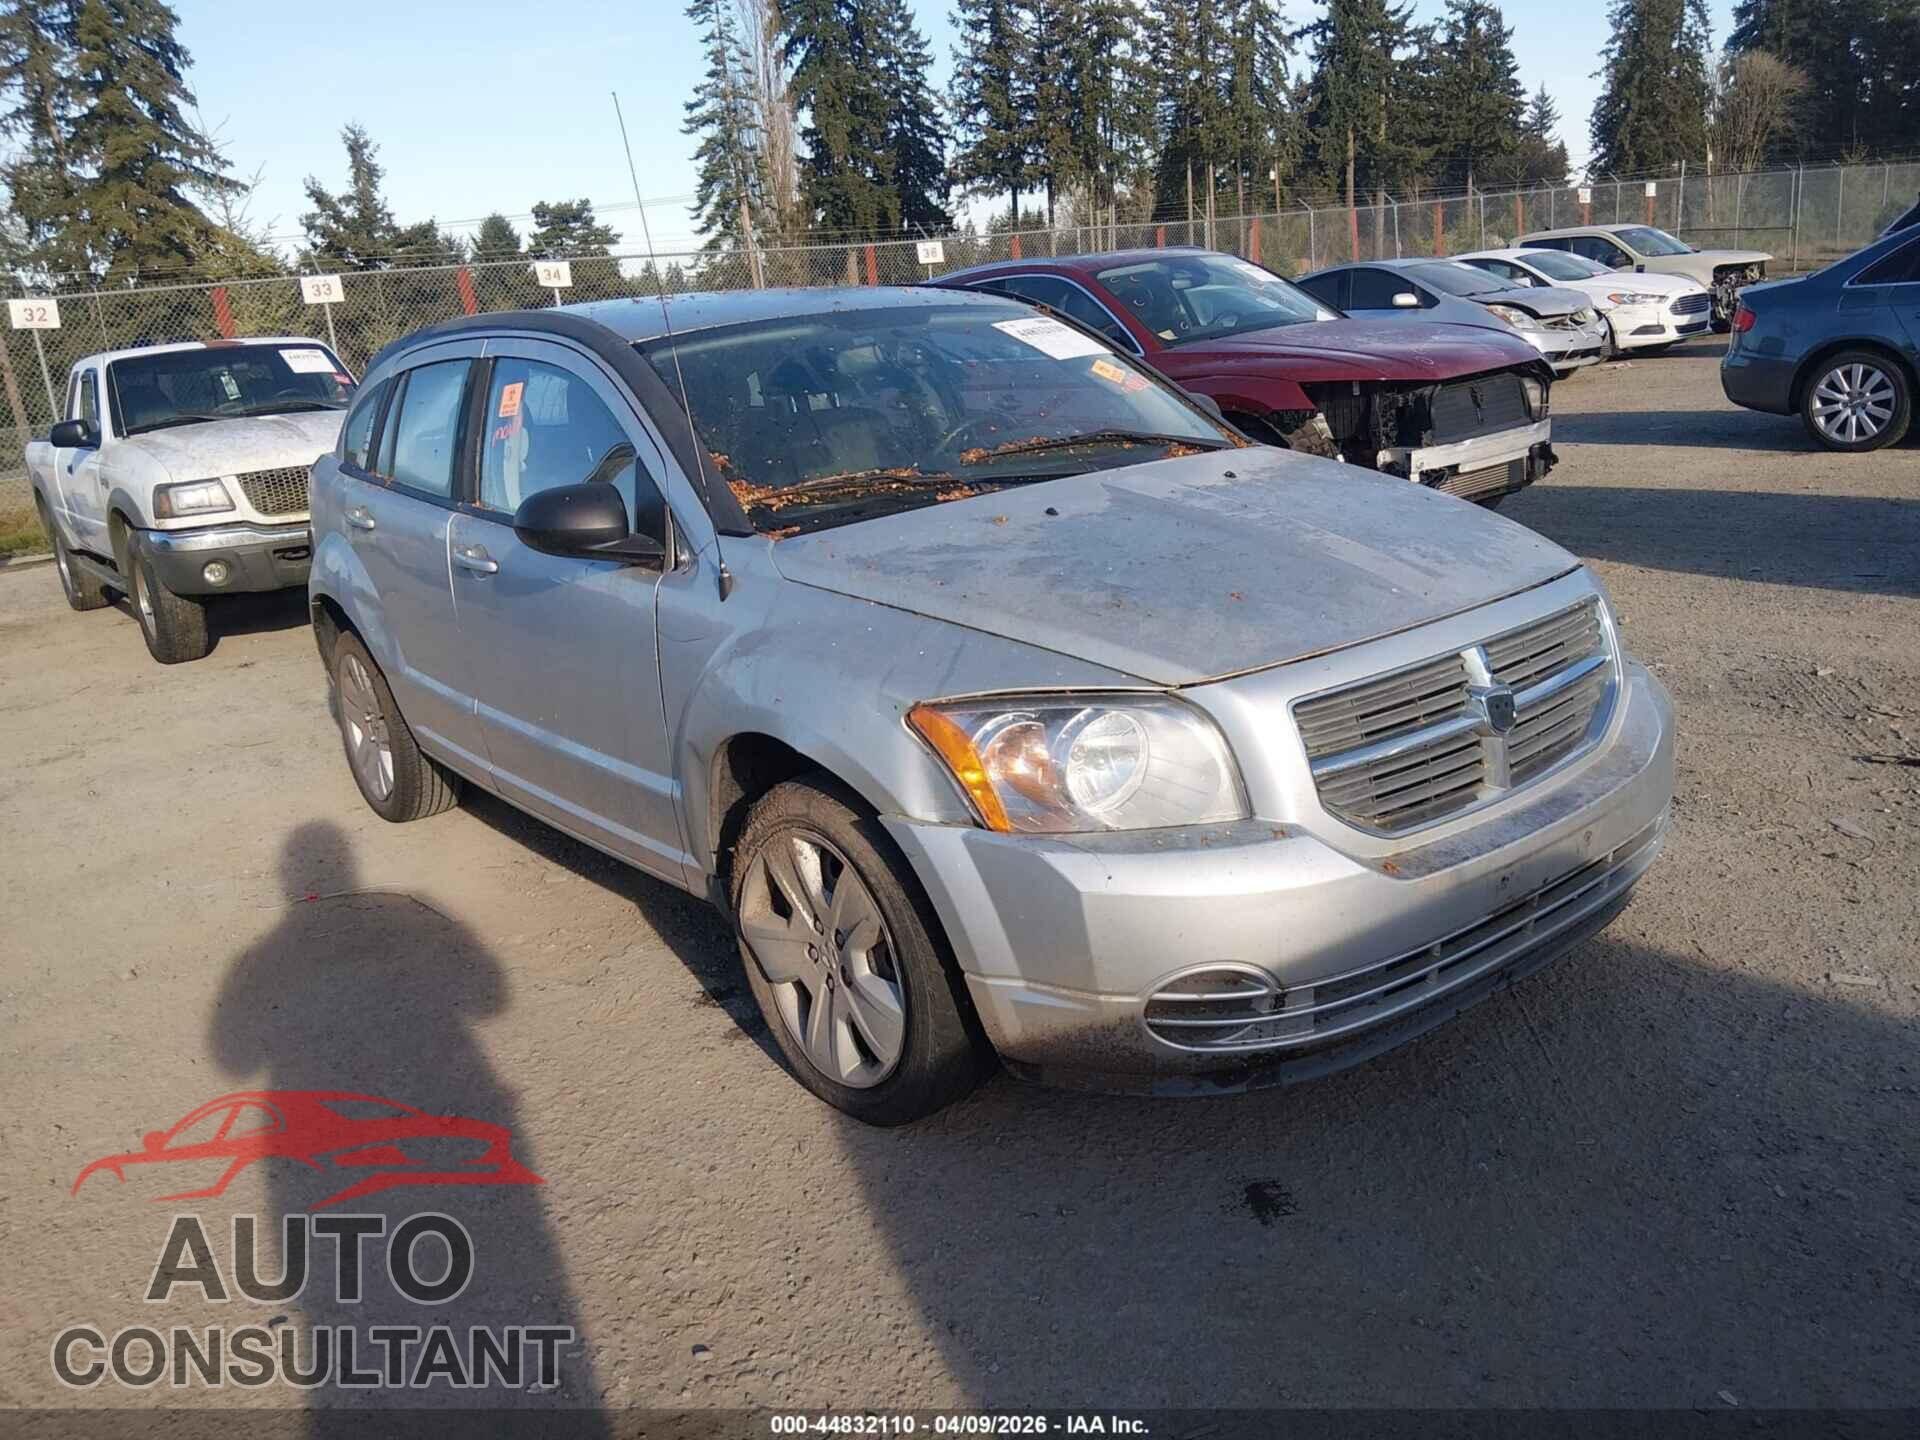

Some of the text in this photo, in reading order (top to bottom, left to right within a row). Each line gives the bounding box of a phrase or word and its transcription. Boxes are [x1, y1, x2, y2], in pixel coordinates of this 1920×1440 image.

[543, 268, 561, 281] 34
[311, 282, 333, 297] 33
[23, 306, 48, 322] 32
